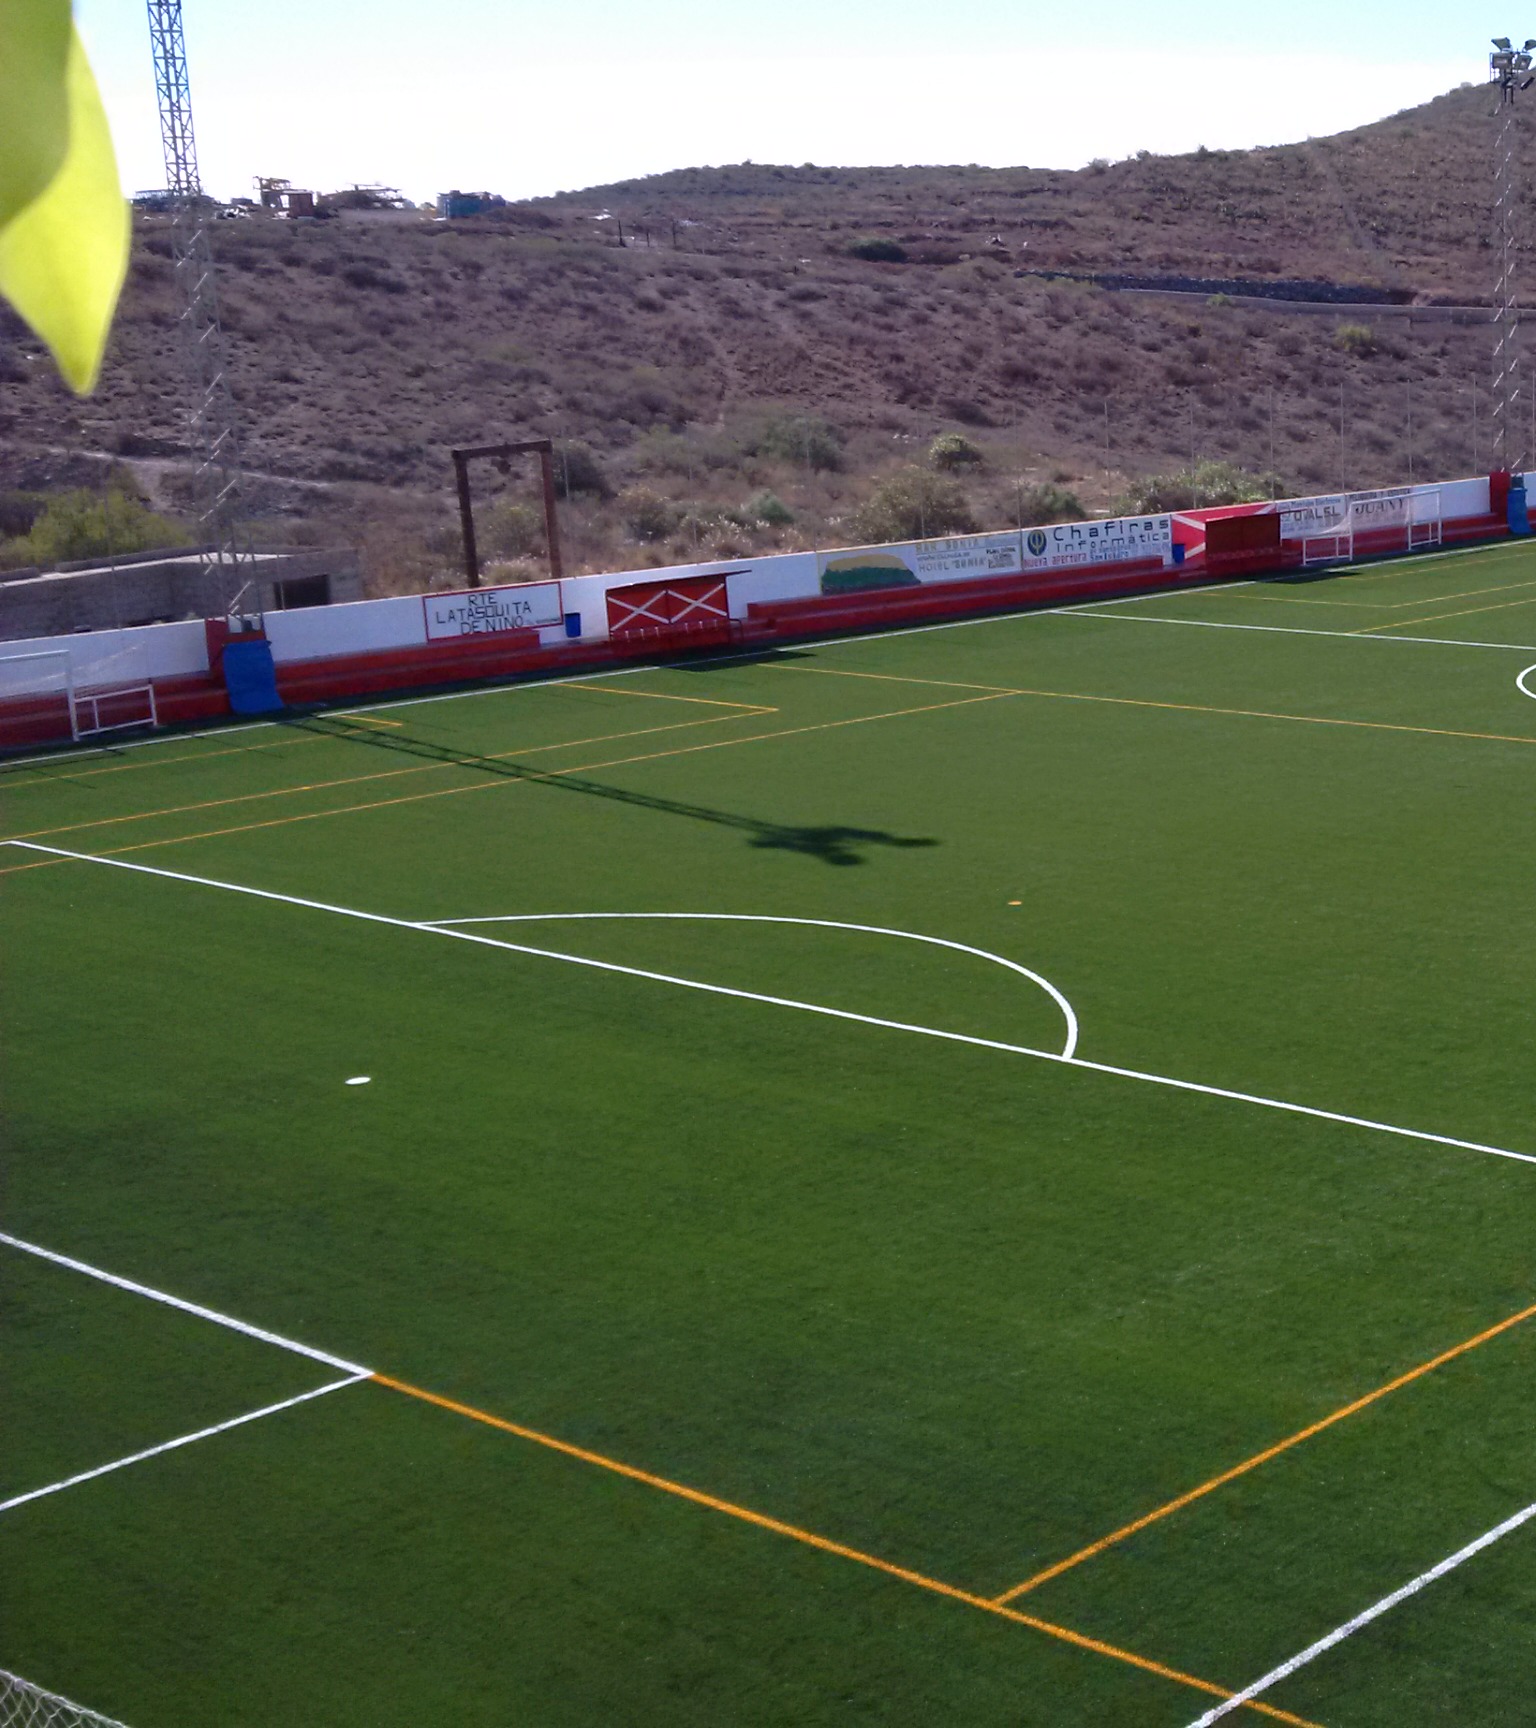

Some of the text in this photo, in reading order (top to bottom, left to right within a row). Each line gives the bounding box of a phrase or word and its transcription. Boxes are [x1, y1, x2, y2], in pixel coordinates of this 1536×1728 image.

[1053, 519, 1169, 542] Chafiras
[468, 592, 498, 607] RTE
[460, 621, 481, 635] DE
